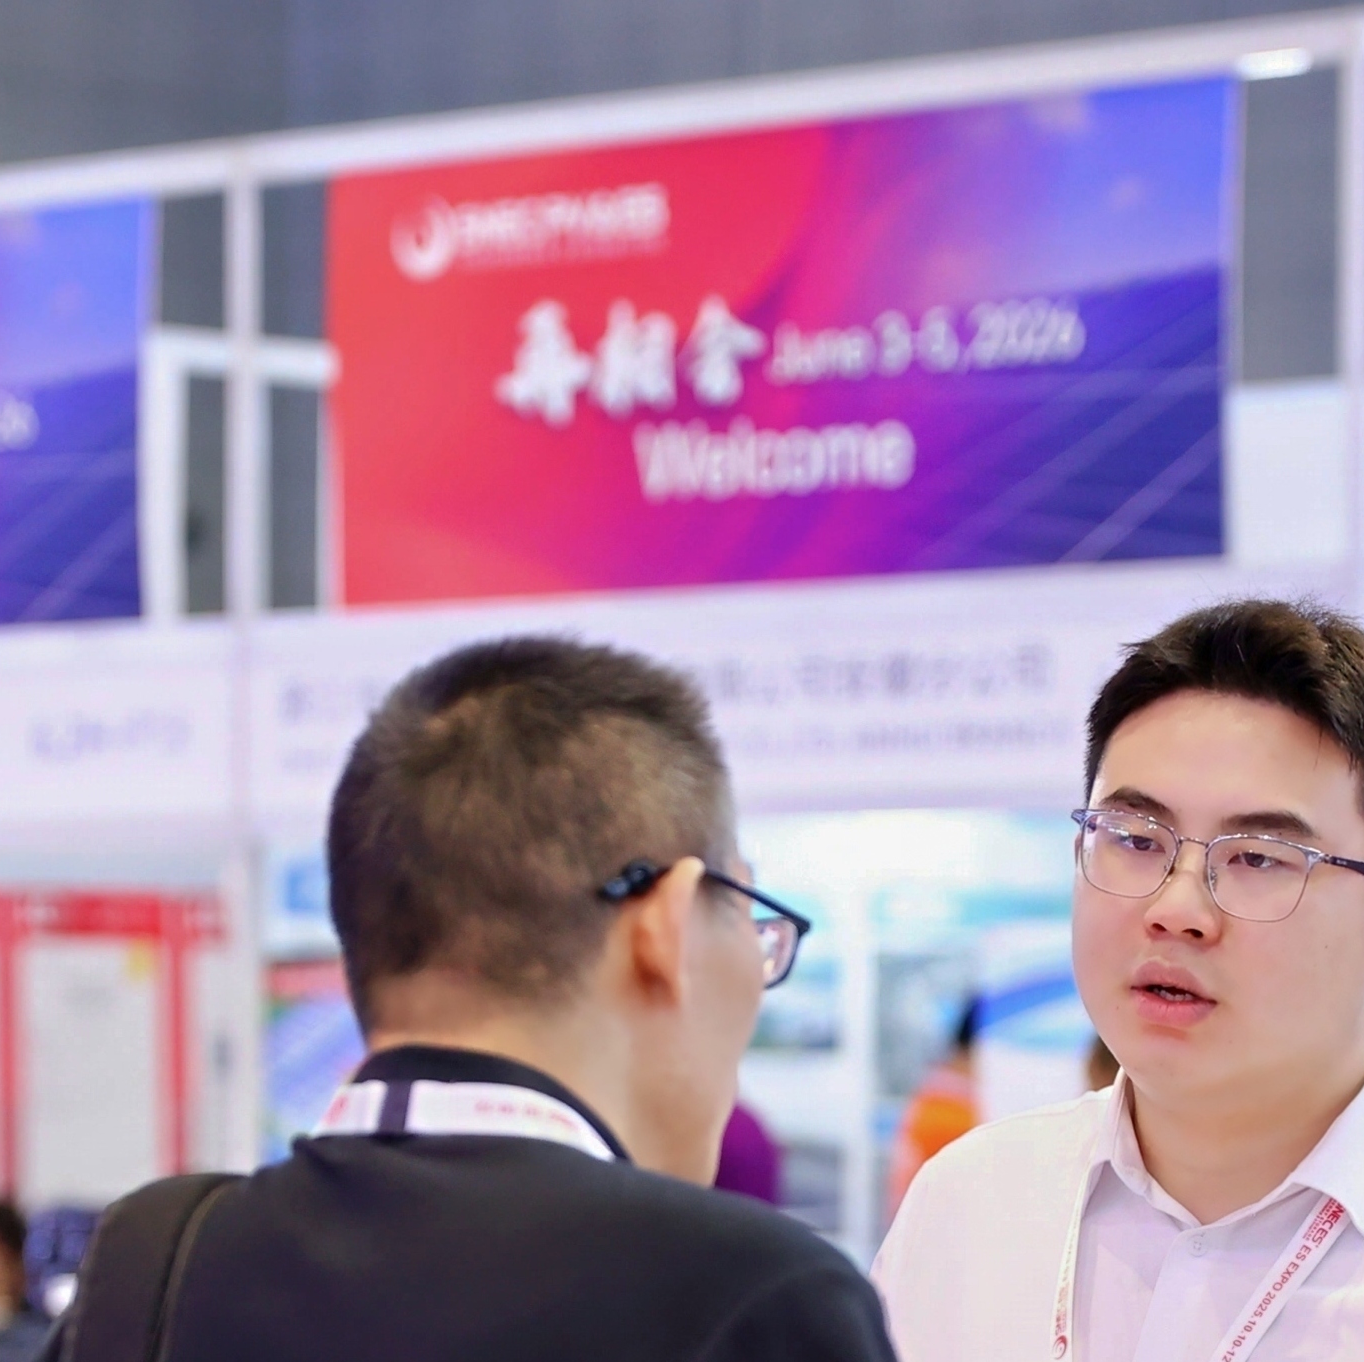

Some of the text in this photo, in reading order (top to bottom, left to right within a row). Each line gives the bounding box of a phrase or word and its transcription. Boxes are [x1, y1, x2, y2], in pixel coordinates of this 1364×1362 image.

[764, 322, 877, 385] June
[632, 414, 916, 503] Welcome
[1272, 1261, 1300, 1292] EXPO
[1295, 1244, 1312, 1262] ES
